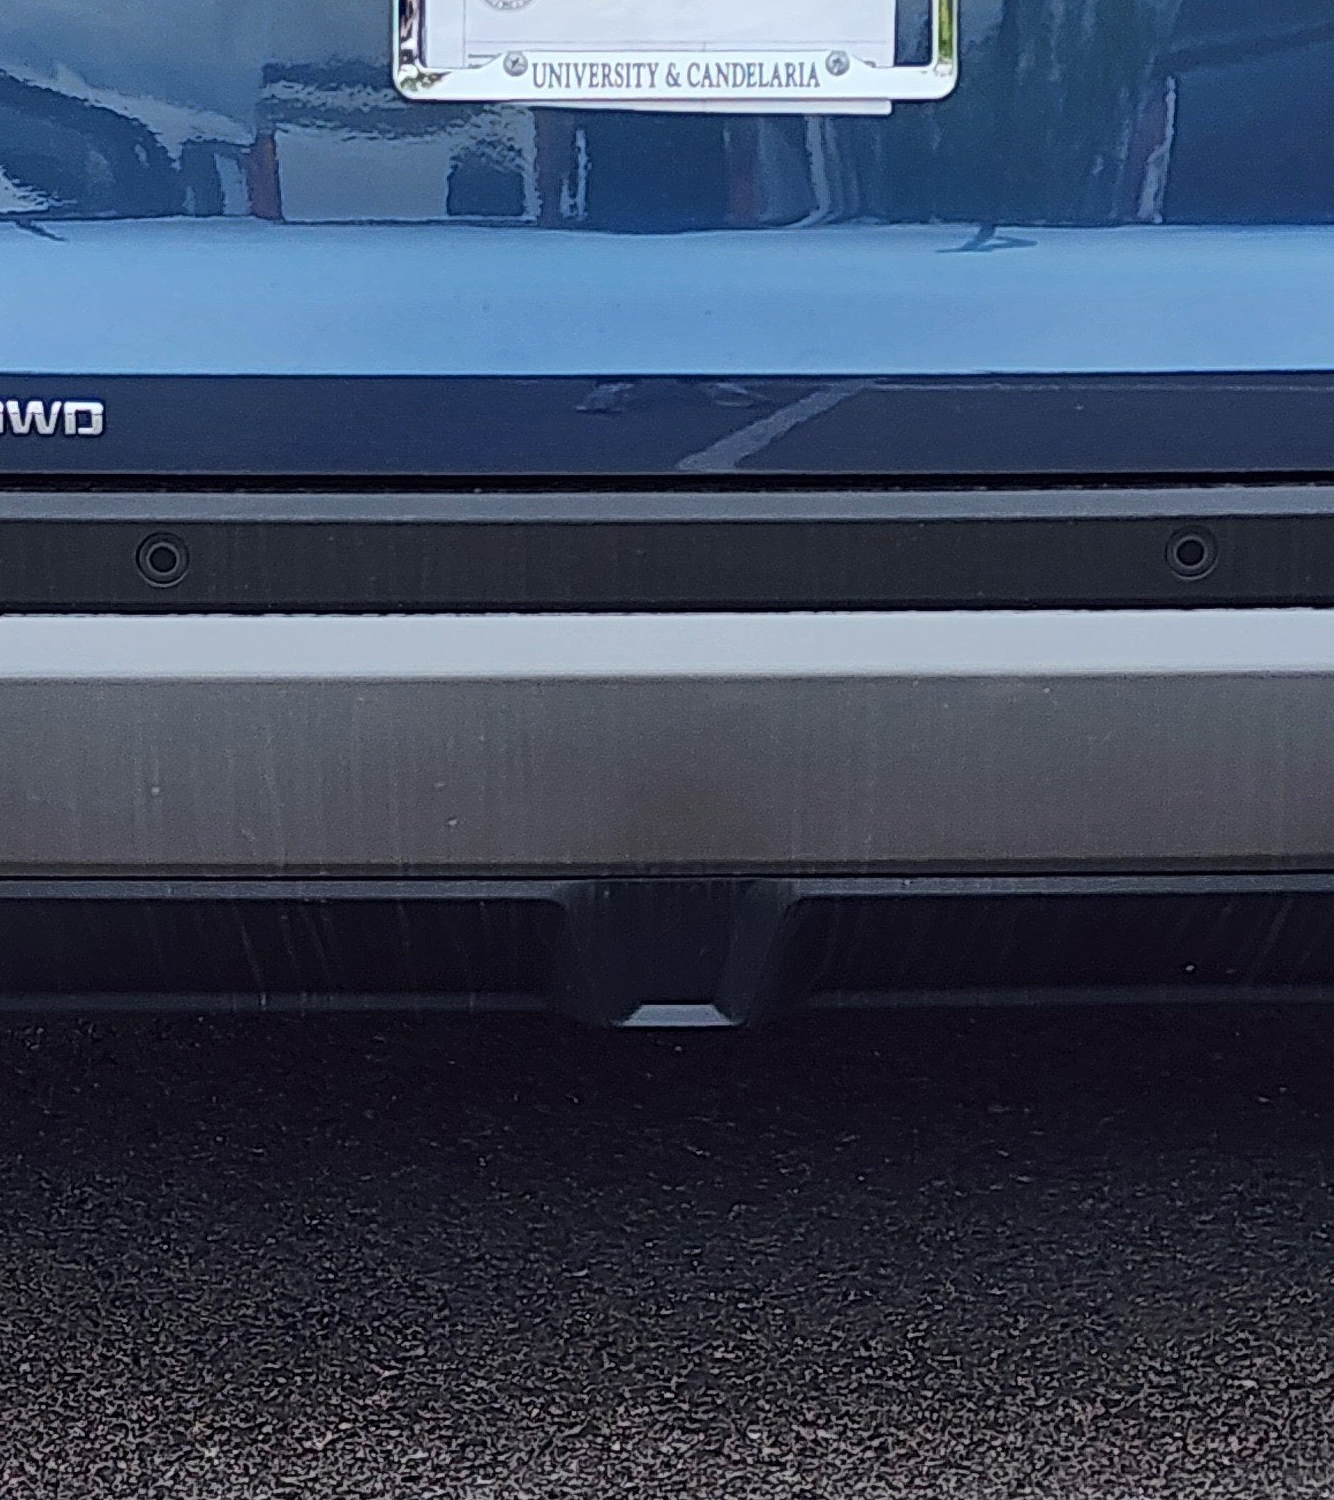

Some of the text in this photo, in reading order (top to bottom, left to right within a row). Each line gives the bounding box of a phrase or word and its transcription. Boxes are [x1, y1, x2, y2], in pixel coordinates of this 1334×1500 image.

[532, 61, 660, 89] UNIVERSITY
[665, 61, 682, 88] &
[686, 61, 822, 90] CANDELARIA
